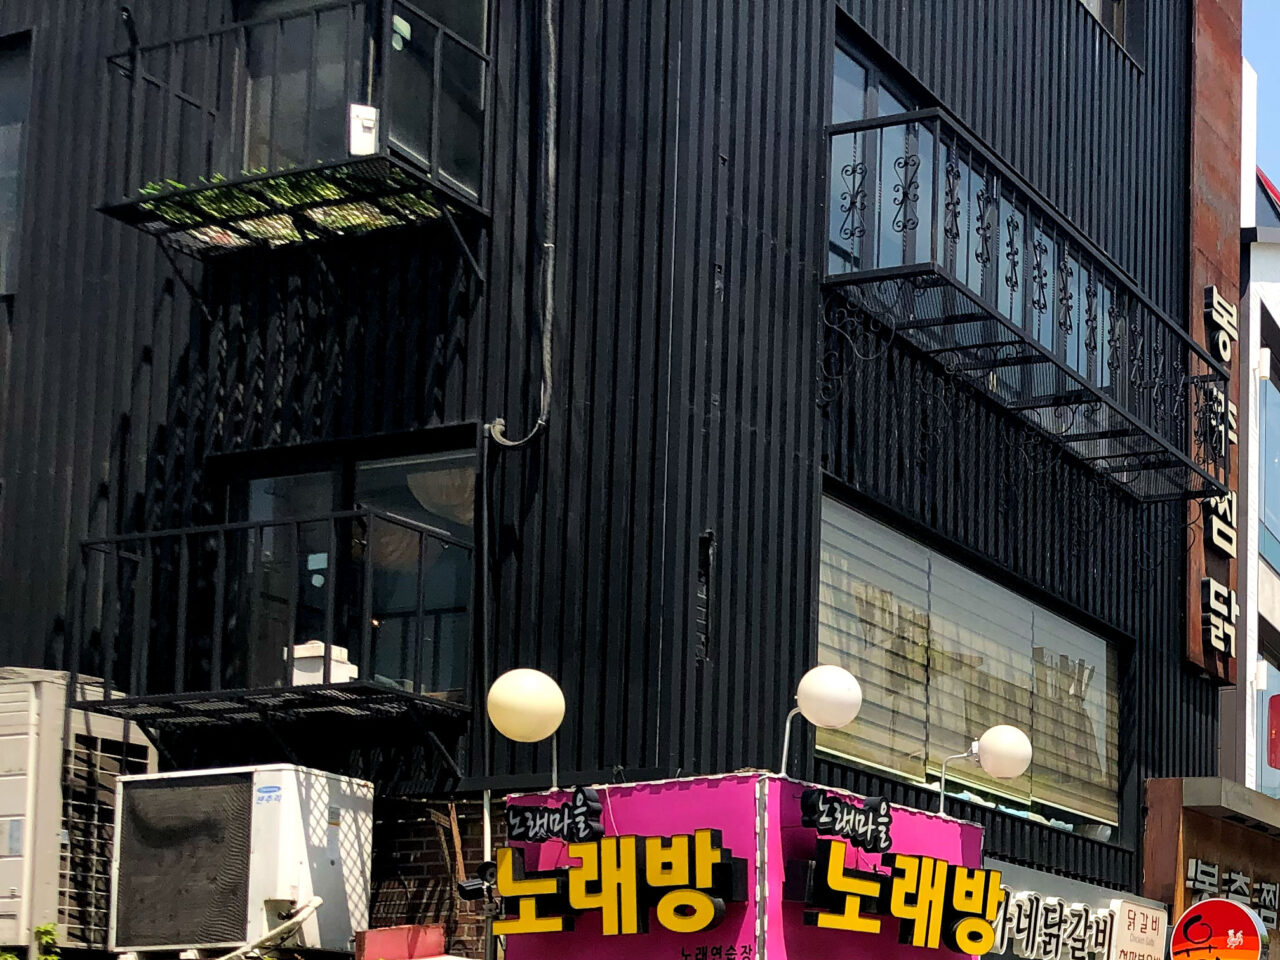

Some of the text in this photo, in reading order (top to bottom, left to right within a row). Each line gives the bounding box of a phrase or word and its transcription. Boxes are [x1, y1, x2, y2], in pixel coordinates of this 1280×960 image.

[493, 829, 721, 936] 노래방
[818, 841, 1005, 956] 노래방
[1127, 909, 1160, 937] 닭갈비
